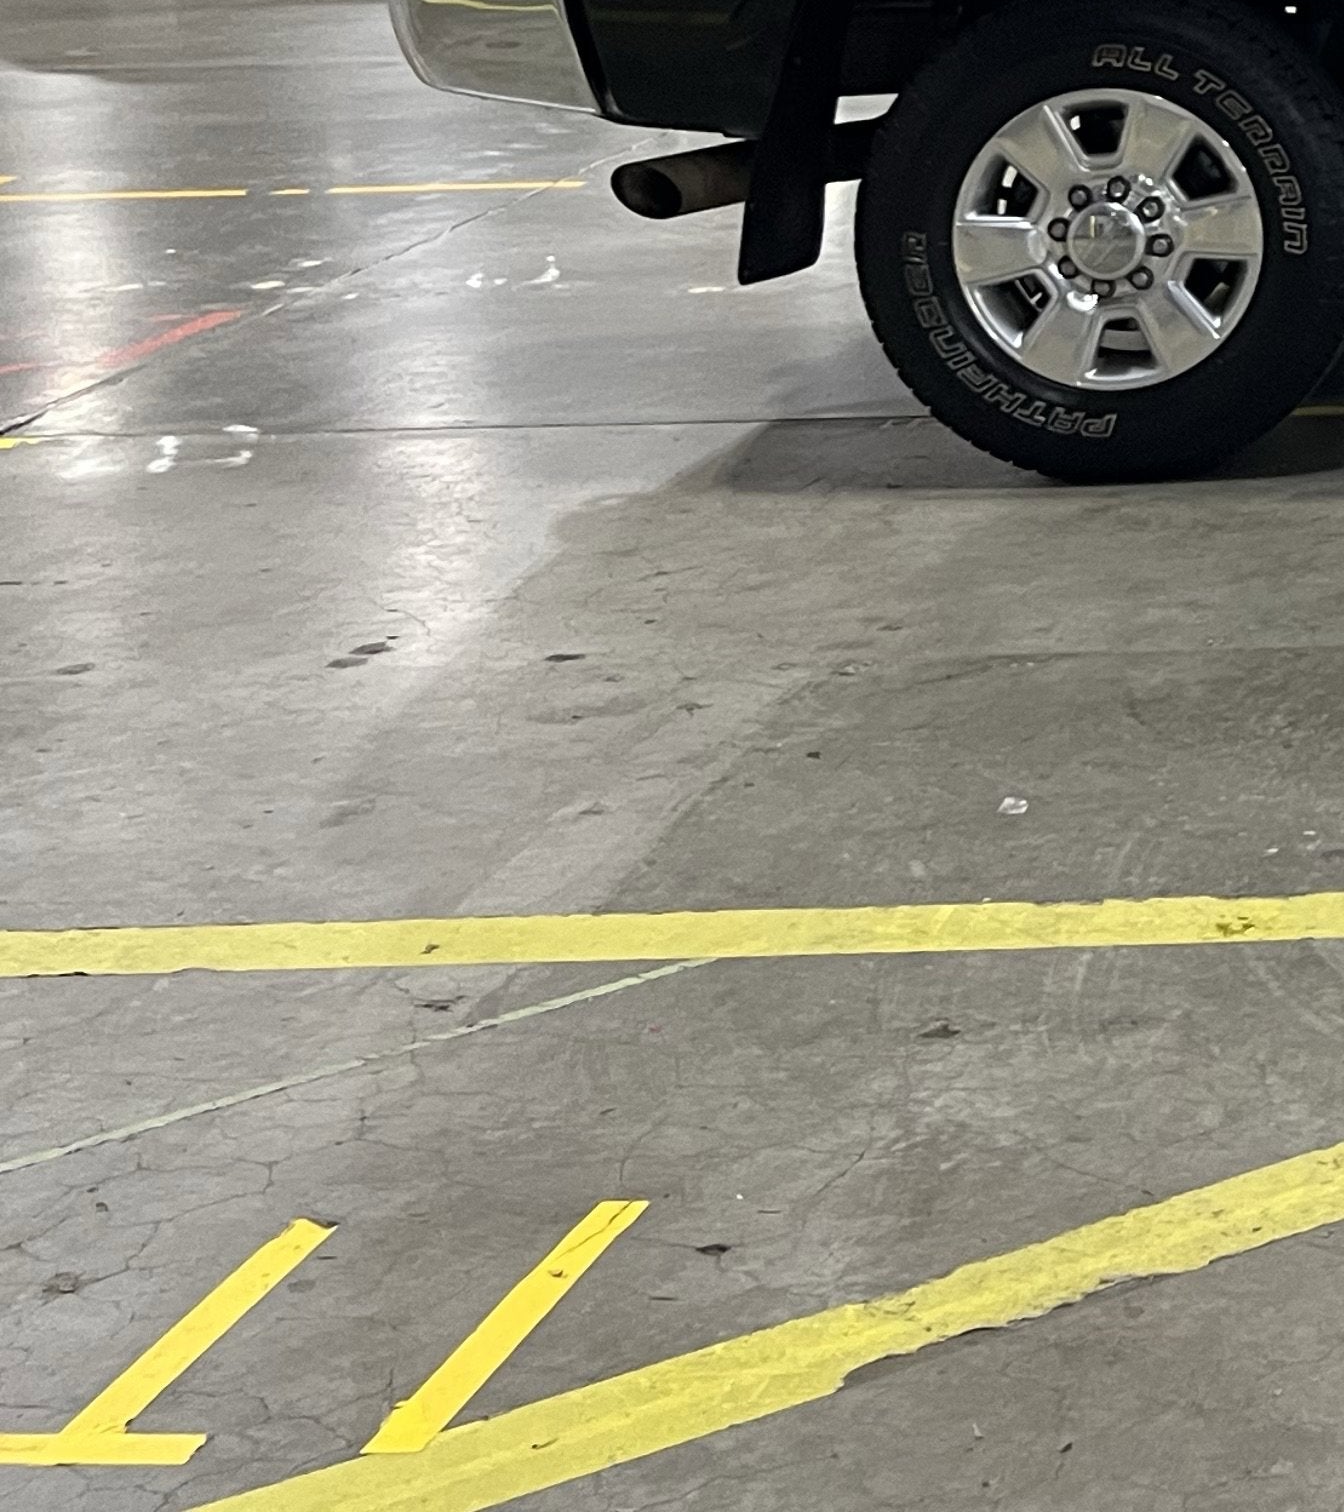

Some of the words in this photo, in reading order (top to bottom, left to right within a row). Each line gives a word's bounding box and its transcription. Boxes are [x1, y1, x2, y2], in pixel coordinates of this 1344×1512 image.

[1091, 43, 1181, 81] ALL
[1192, 69, 1309, 256] TERRAIN
[902, 231, 1119, 439] PATHFINDER
